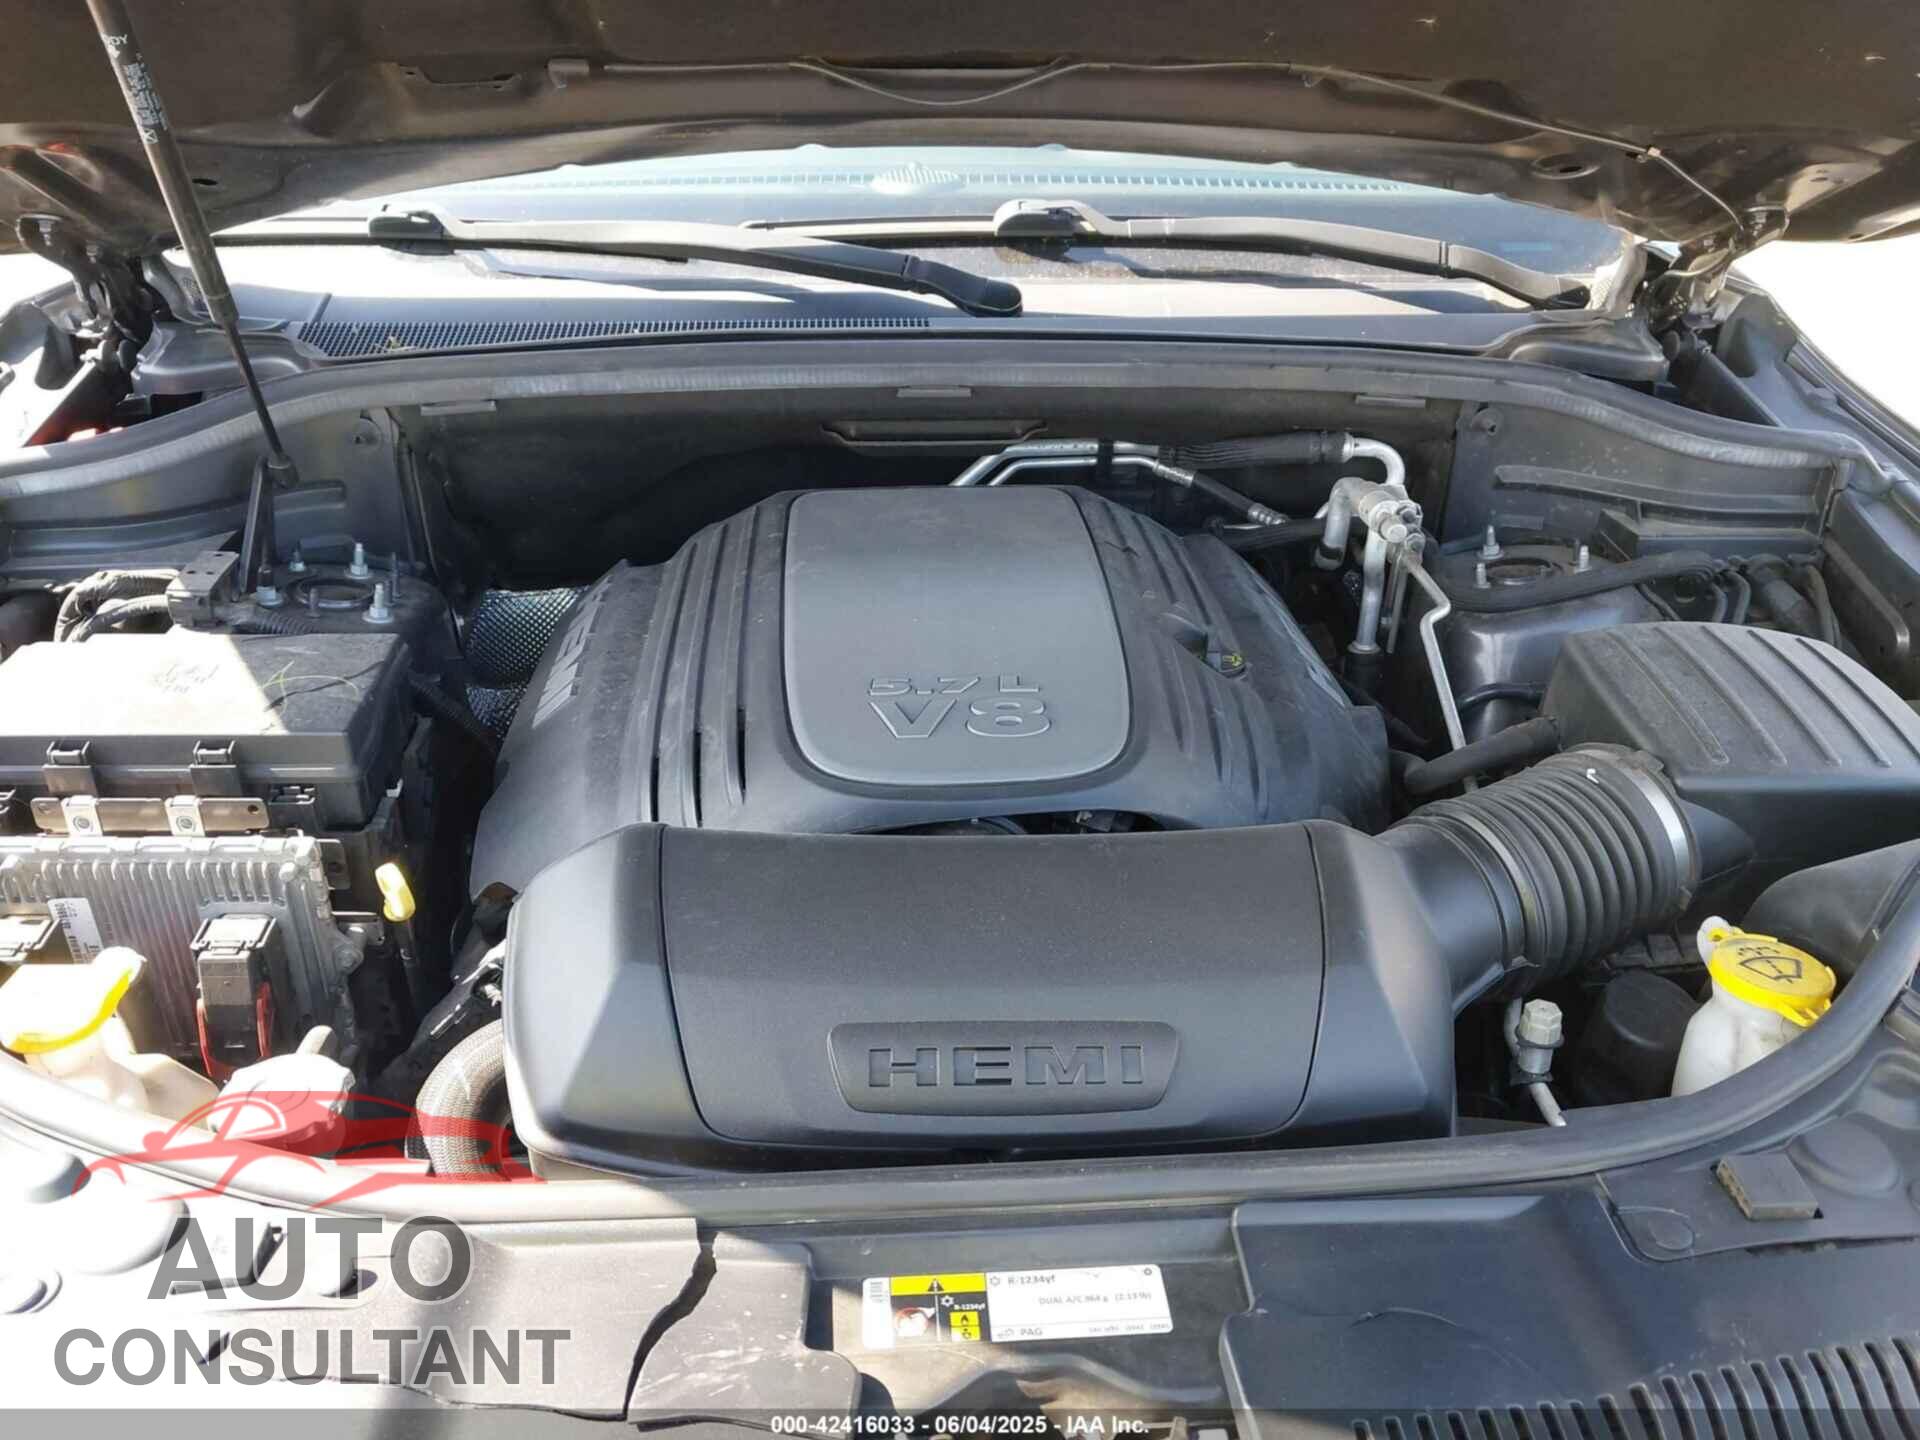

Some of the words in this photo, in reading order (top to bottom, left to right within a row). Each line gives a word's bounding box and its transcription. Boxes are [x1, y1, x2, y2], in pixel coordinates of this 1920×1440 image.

[868, 698, 1052, 739] V8
[867, 1045, 1146, 1088] HEMI
[1020, 1327, 1043, 1336] PAG
